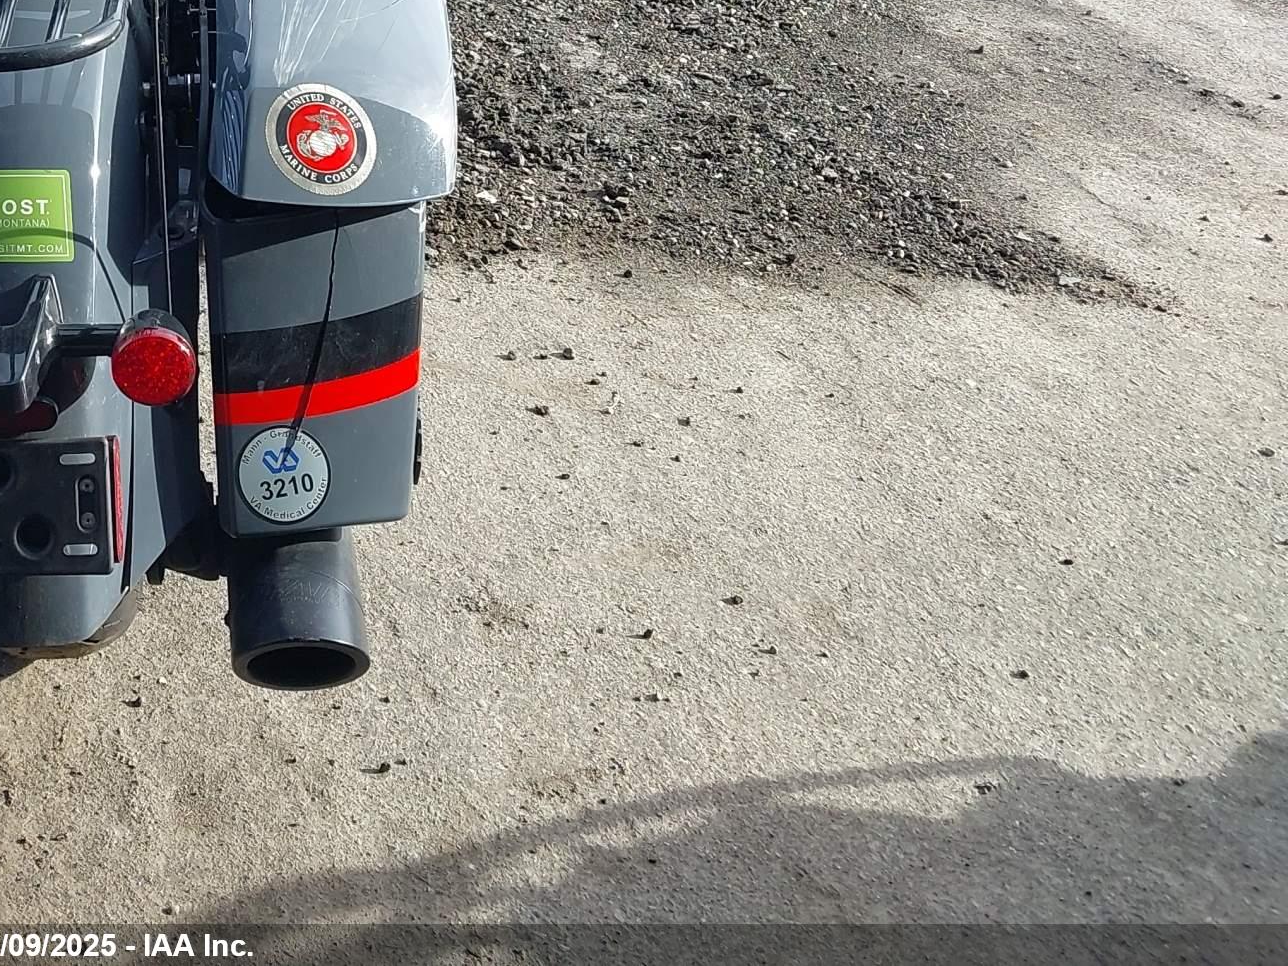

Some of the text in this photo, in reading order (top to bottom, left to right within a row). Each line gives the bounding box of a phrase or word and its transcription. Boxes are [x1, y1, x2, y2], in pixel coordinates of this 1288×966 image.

[287, 94, 361, 129] UNITED STATES
[280, 144, 358, 183] MARINE CORPS
[242, 439, 262, 465] Mann
[250, 477, 327, 519] VA Medical Center
[260, 473, 314, 500] 3210
